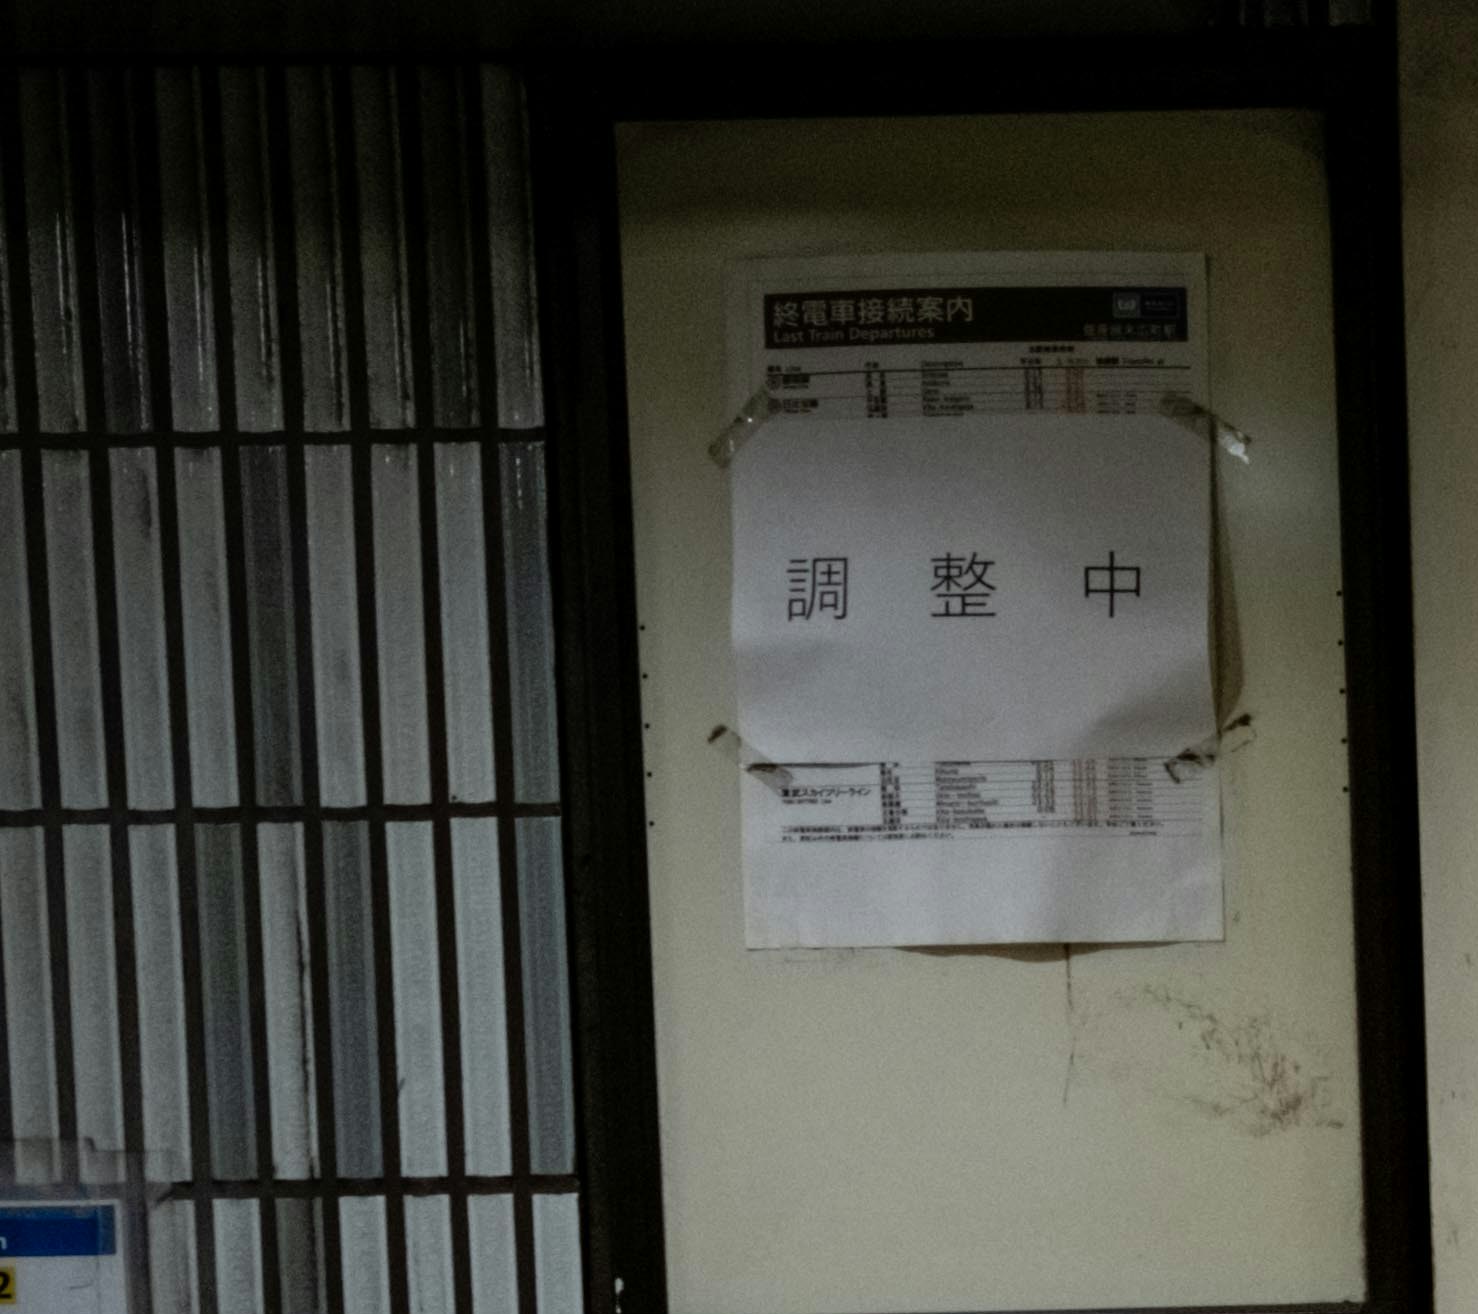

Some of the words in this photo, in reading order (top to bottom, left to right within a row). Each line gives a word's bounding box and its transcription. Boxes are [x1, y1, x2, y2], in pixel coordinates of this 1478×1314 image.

[772, 296, 975, 327] 終電車接続案内
[773, 329, 804, 343] Last
[808, 328, 845, 342] Train
[849, 327, 935, 341] Departures
[786, 556, 850, 622] 調
[929, 551, 998, 621] 整
[1083, 549, 1142, 620] 中
